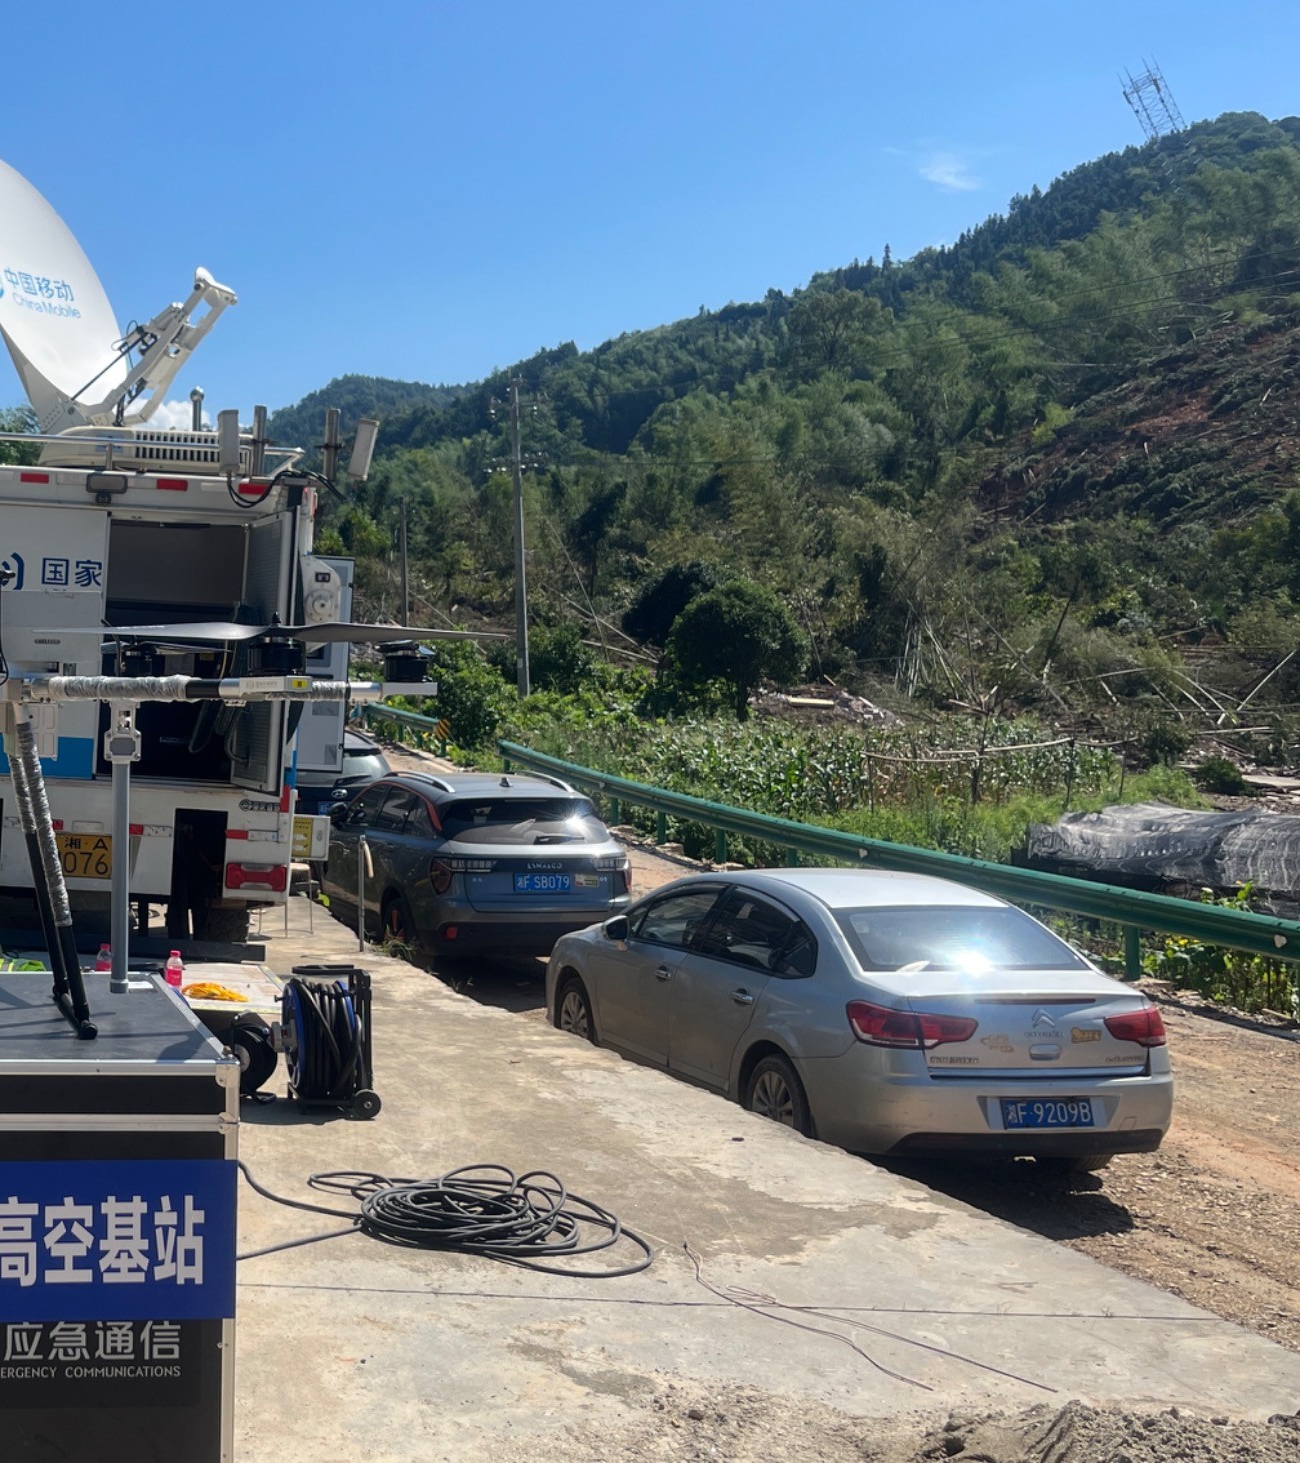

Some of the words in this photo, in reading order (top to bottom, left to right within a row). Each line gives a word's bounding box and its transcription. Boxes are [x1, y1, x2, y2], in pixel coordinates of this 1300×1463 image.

[4, 267, 74, 301] 中国移动
[41, 557, 102, 587] 国家
[63, 851, 109, 875] 076
[65, 1365, 181, 1378] COMMUNICATIONS
